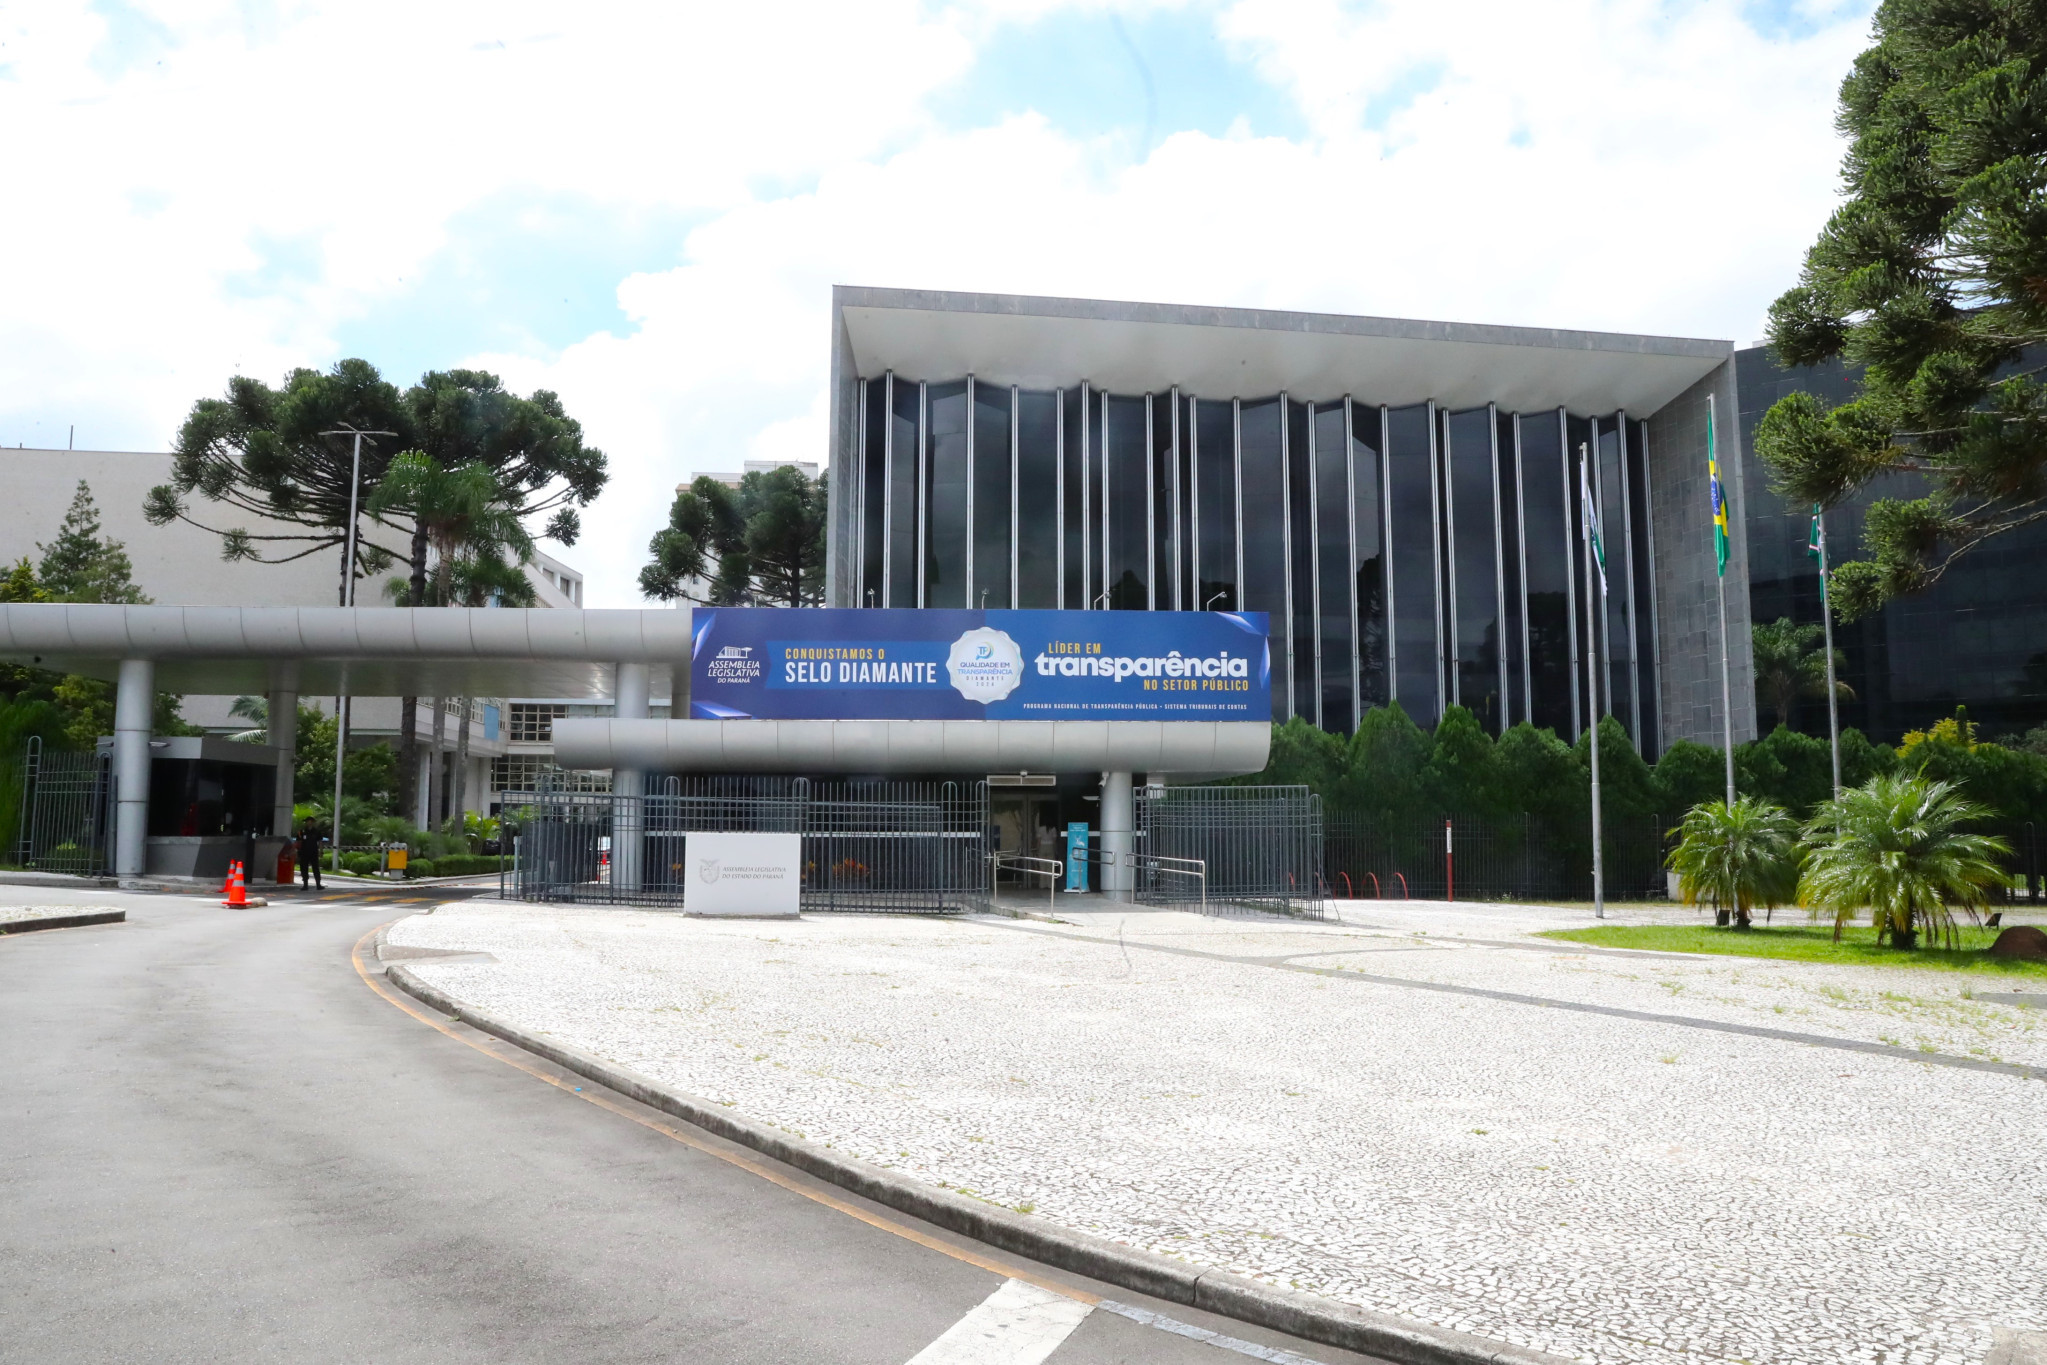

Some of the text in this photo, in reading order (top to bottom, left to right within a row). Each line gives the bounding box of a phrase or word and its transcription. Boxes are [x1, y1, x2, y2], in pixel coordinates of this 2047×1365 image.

[1048, 641, 1101, 654] LÍDER EM
[785, 648, 885, 660] CONQUISTAMOS O
[708, 660, 760, 669] ASSEMBLEIA
[1034, 650, 1248, 683] transparência
[707, 668, 760, 677] LEGISLATIVA
[785, 661, 937, 683] SELO DIAMANTE
[727, 676, 751, 684] PARANÁ
[1144, 677, 1249, 691] NO SETOR PÚBLICO
